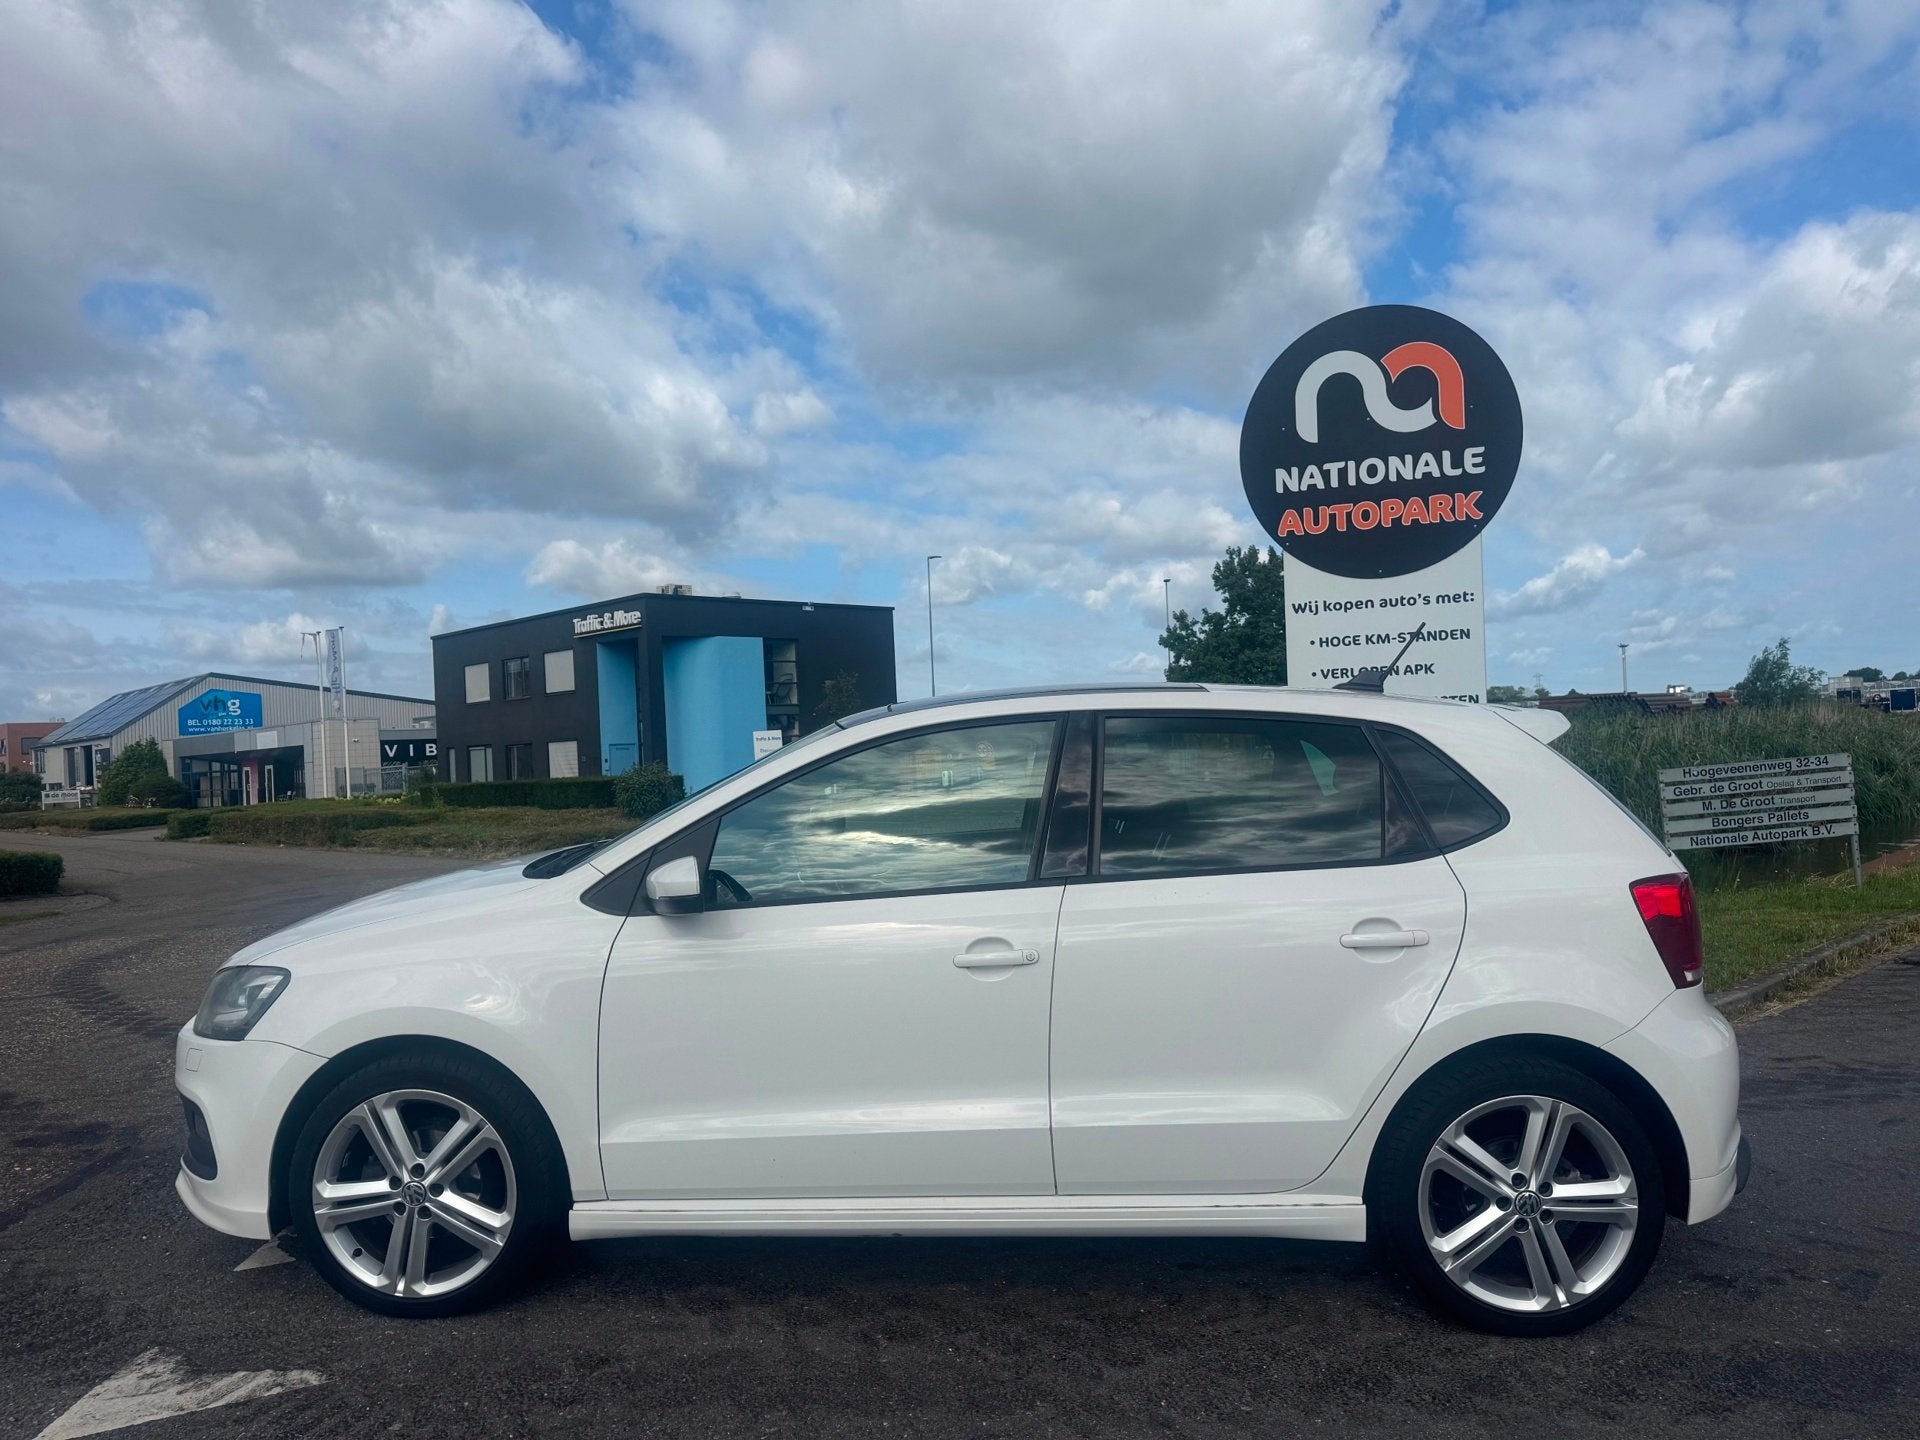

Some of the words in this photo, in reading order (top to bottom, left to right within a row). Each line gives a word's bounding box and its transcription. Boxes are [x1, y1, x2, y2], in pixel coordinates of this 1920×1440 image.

[1275, 446, 1486, 493] NATIONALE
[1278, 490, 1484, 537] AUTOPARK
[1291, 600, 1319, 615] Wij
[1323, 599, 1375, 613] kopen
[1379, 593, 1431, 608] auto's
[1435, 590, 1475, 604] met:
[572, 614, 603, 634] Traffic
[603, 612, 613, 629] &
[613, 610, 642, 627] More
[1319, 634, 1361, 648] HOGE
[1365, 628, 1471, 645] KM-STANDEN
[1403, 663, 1435, 676] APK
[200, 695, 242, 716] vhg
[1682, 761, 1792, 778] Hoogeveenenweg
[1796, 756, 1829, 768] 32-34
[1673, 786, 1706, 796] Gebr.
[1709, 784, 1724, 793] de
[1728, 780, 1763, 792] Groot
[1766, 780, 1794, 790] Opslag
[1804, 775, 1842, 785] Transport
[1702, 801, 1716, 811] M.
[1720, 799, 1736, 809] De
[1740, 796, 1775, 807] Groot
[1778, 795, 1816, 804] Transport
[1712, 816, 1764, 828] Bongers
[1768, 811, 1809, 822] Pallets
[1690, 833, 1748, 846] Nationale
[1752, 828, 1808, 841] Autopark
[1812, 825, 1836, 836] B.V.
